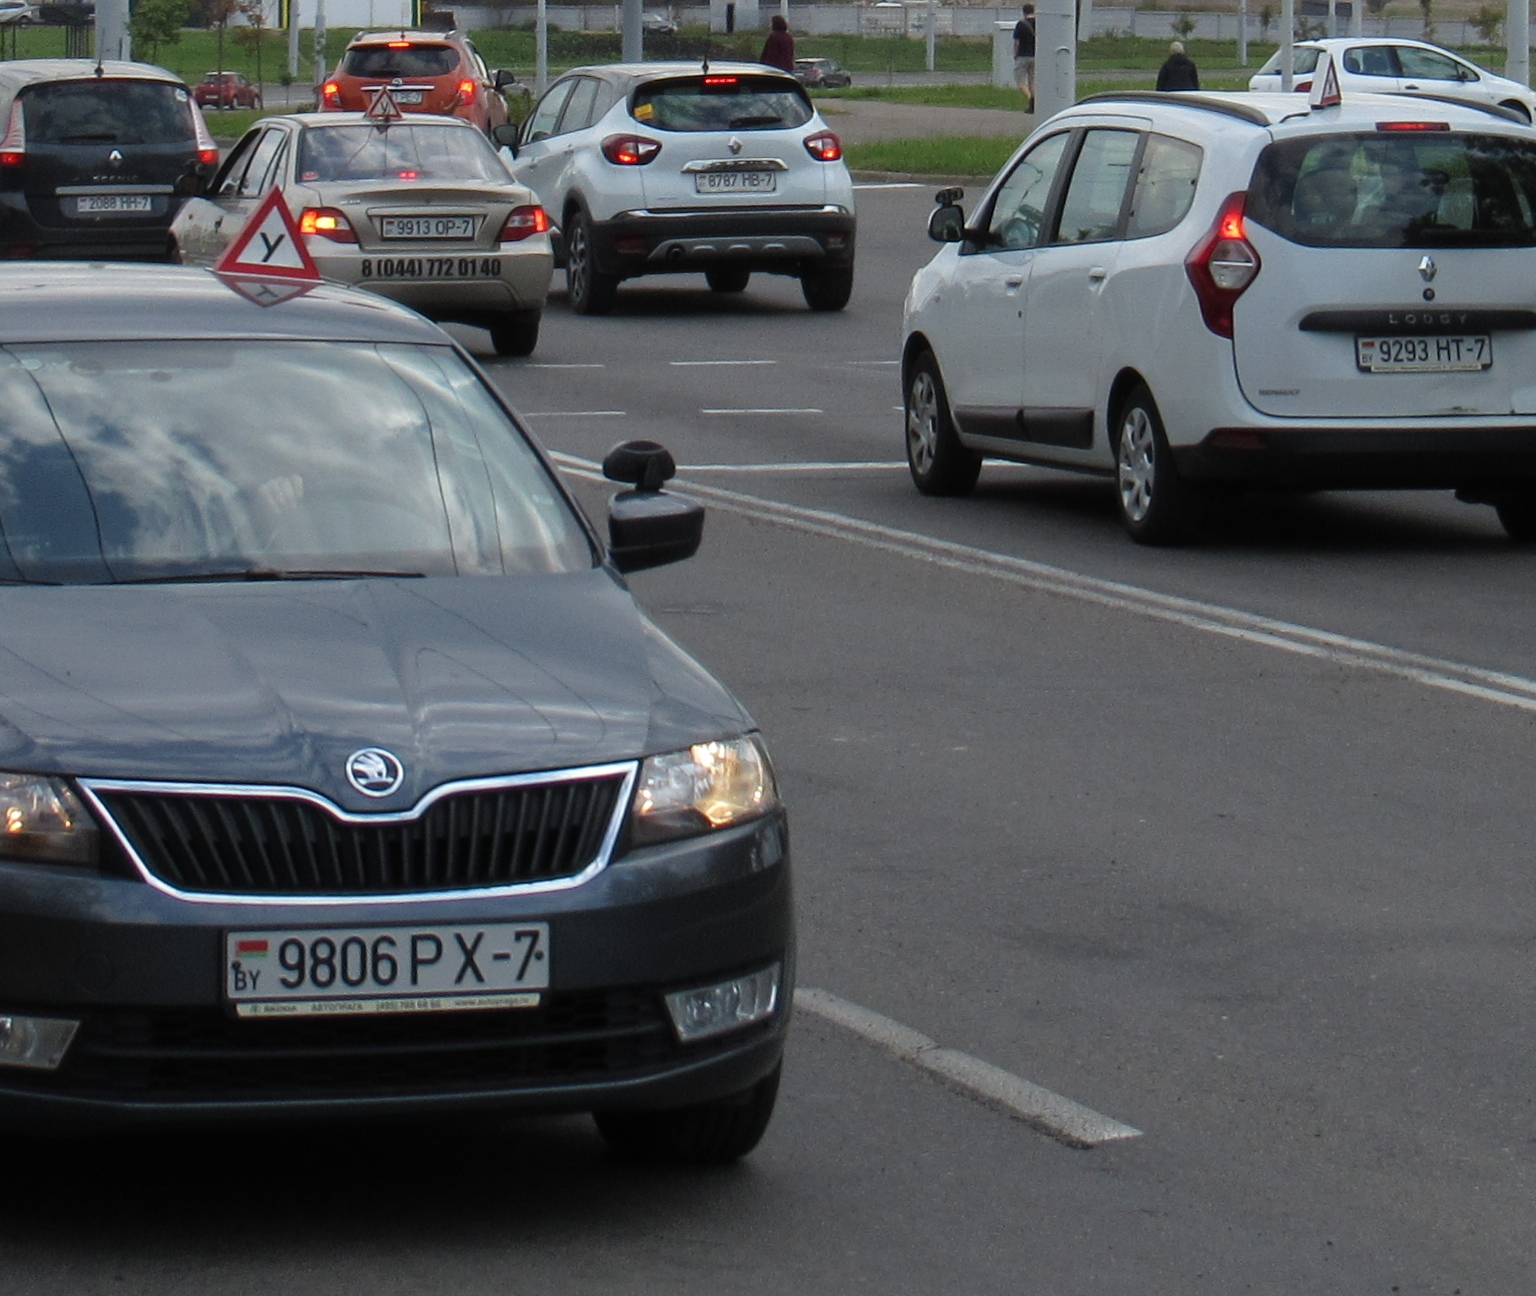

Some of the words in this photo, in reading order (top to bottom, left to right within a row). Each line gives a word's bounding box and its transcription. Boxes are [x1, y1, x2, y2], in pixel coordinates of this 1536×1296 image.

[397, 221, 430, 235] 9913
[435, 220, 469, 234] OP-7
[363, 259, 372, 277] 8
[377, 258, 422, 278] (044)
[427, 259, 453, 276] 772
[1389, 314, 1468, 324] LODGY
[1379, 340, 1429, 362] 9293
[1436, 338, 1486, 361] HT-7
[278, 935, 399, 988] 9806
[410, 930, 541, 985] PX-7
[234, 970, 261, 991] BY
